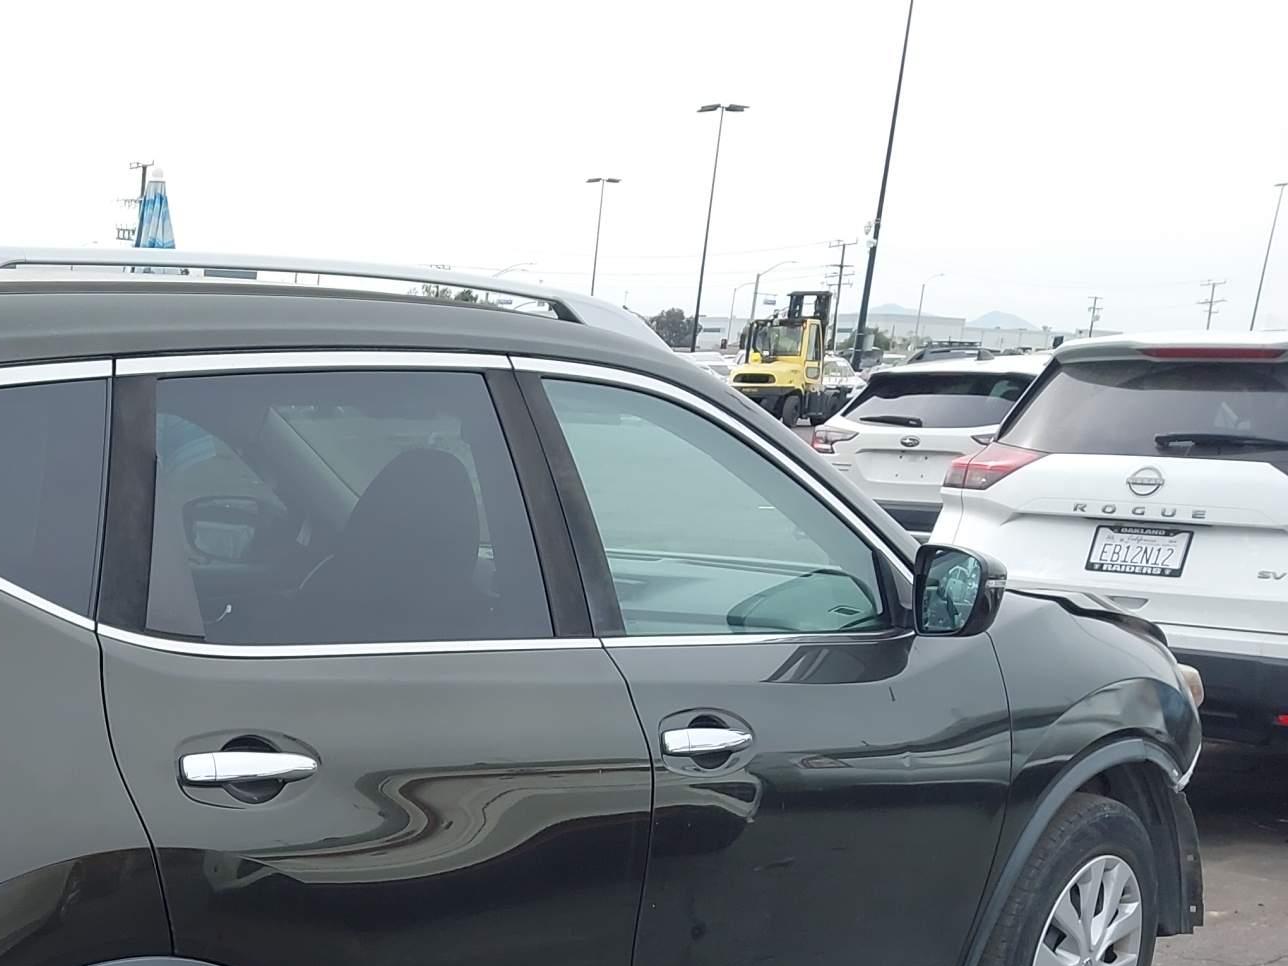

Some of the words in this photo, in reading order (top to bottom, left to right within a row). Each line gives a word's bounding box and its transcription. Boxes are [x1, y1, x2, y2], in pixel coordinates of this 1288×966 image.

[1072, 503, 1207, 519] ROGUE
[1120, 527, 1166, 536] OAKLAND
[1098, 543, 1175, 567] EB12N12
[1102, 563, 1162, 575] RAIDERS
[1257, 570, 1287, 580] SV
